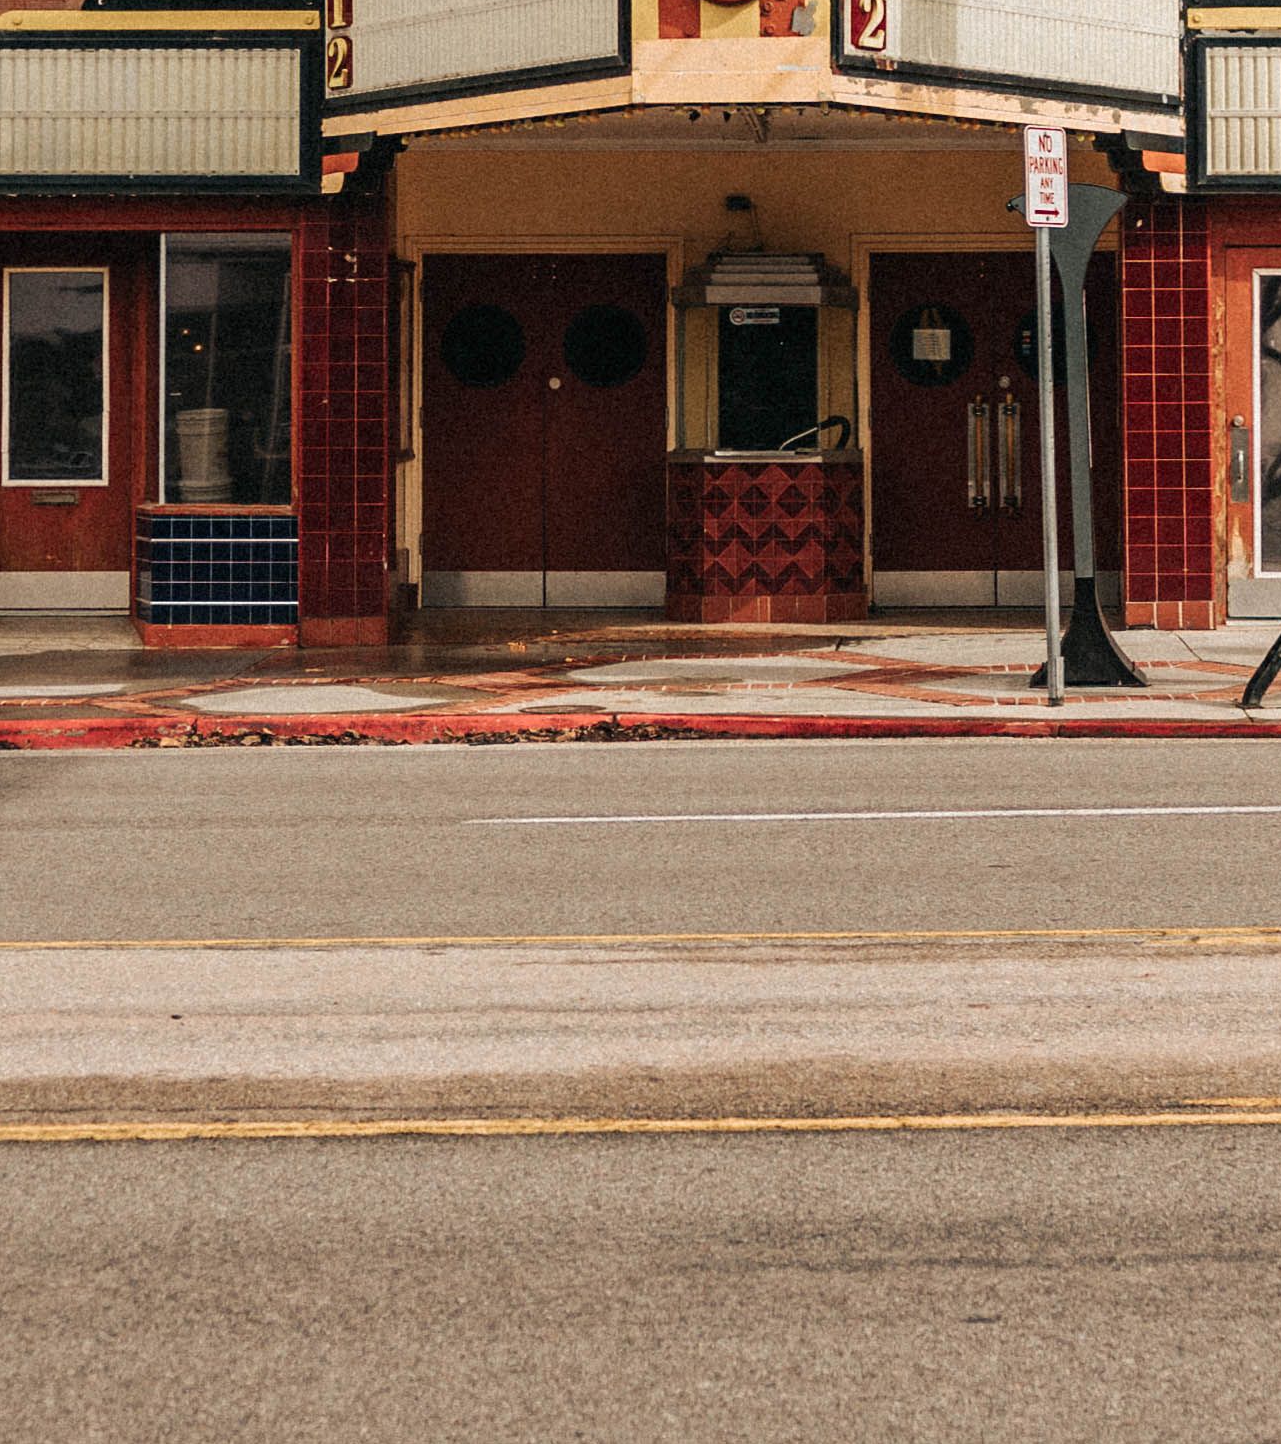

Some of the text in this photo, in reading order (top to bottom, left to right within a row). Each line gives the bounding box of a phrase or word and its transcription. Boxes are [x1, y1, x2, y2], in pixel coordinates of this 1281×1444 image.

[328, 37, 348, 88] 2
[1038, 134, 1053, 153] NO
[1029, 156, 1064, 175] PARKING
[1040, 177, 1053, 189] ANY
[1039, 191, 1055, 205] TIME
